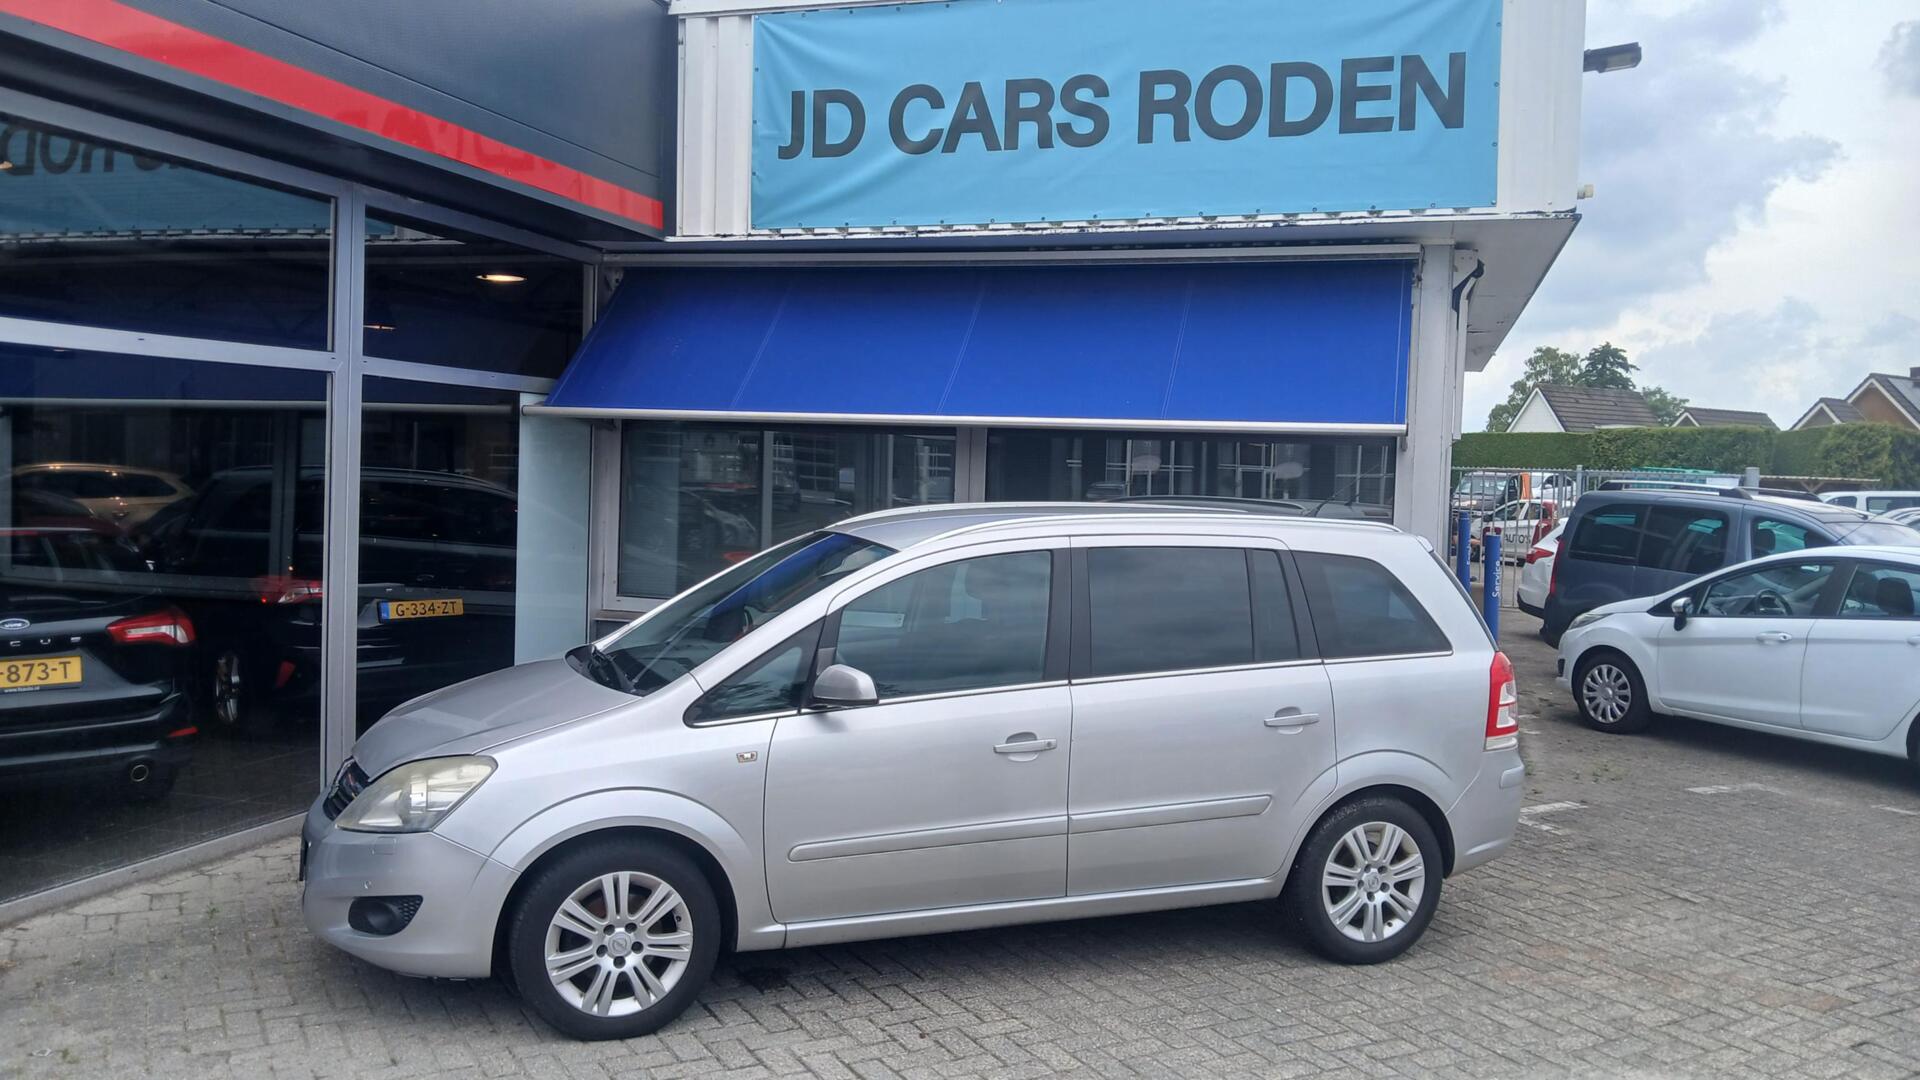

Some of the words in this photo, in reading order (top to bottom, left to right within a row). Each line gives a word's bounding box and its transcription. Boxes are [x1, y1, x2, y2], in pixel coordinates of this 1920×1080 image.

[778, 89, 866, 160] JD
[888, 74, 1110, 155] CARS
[1137, 52, 1466, 144] RODEN
[1491, 560, 1501, 598] Service
[395, 601, 457, 617] G-334-ZT
